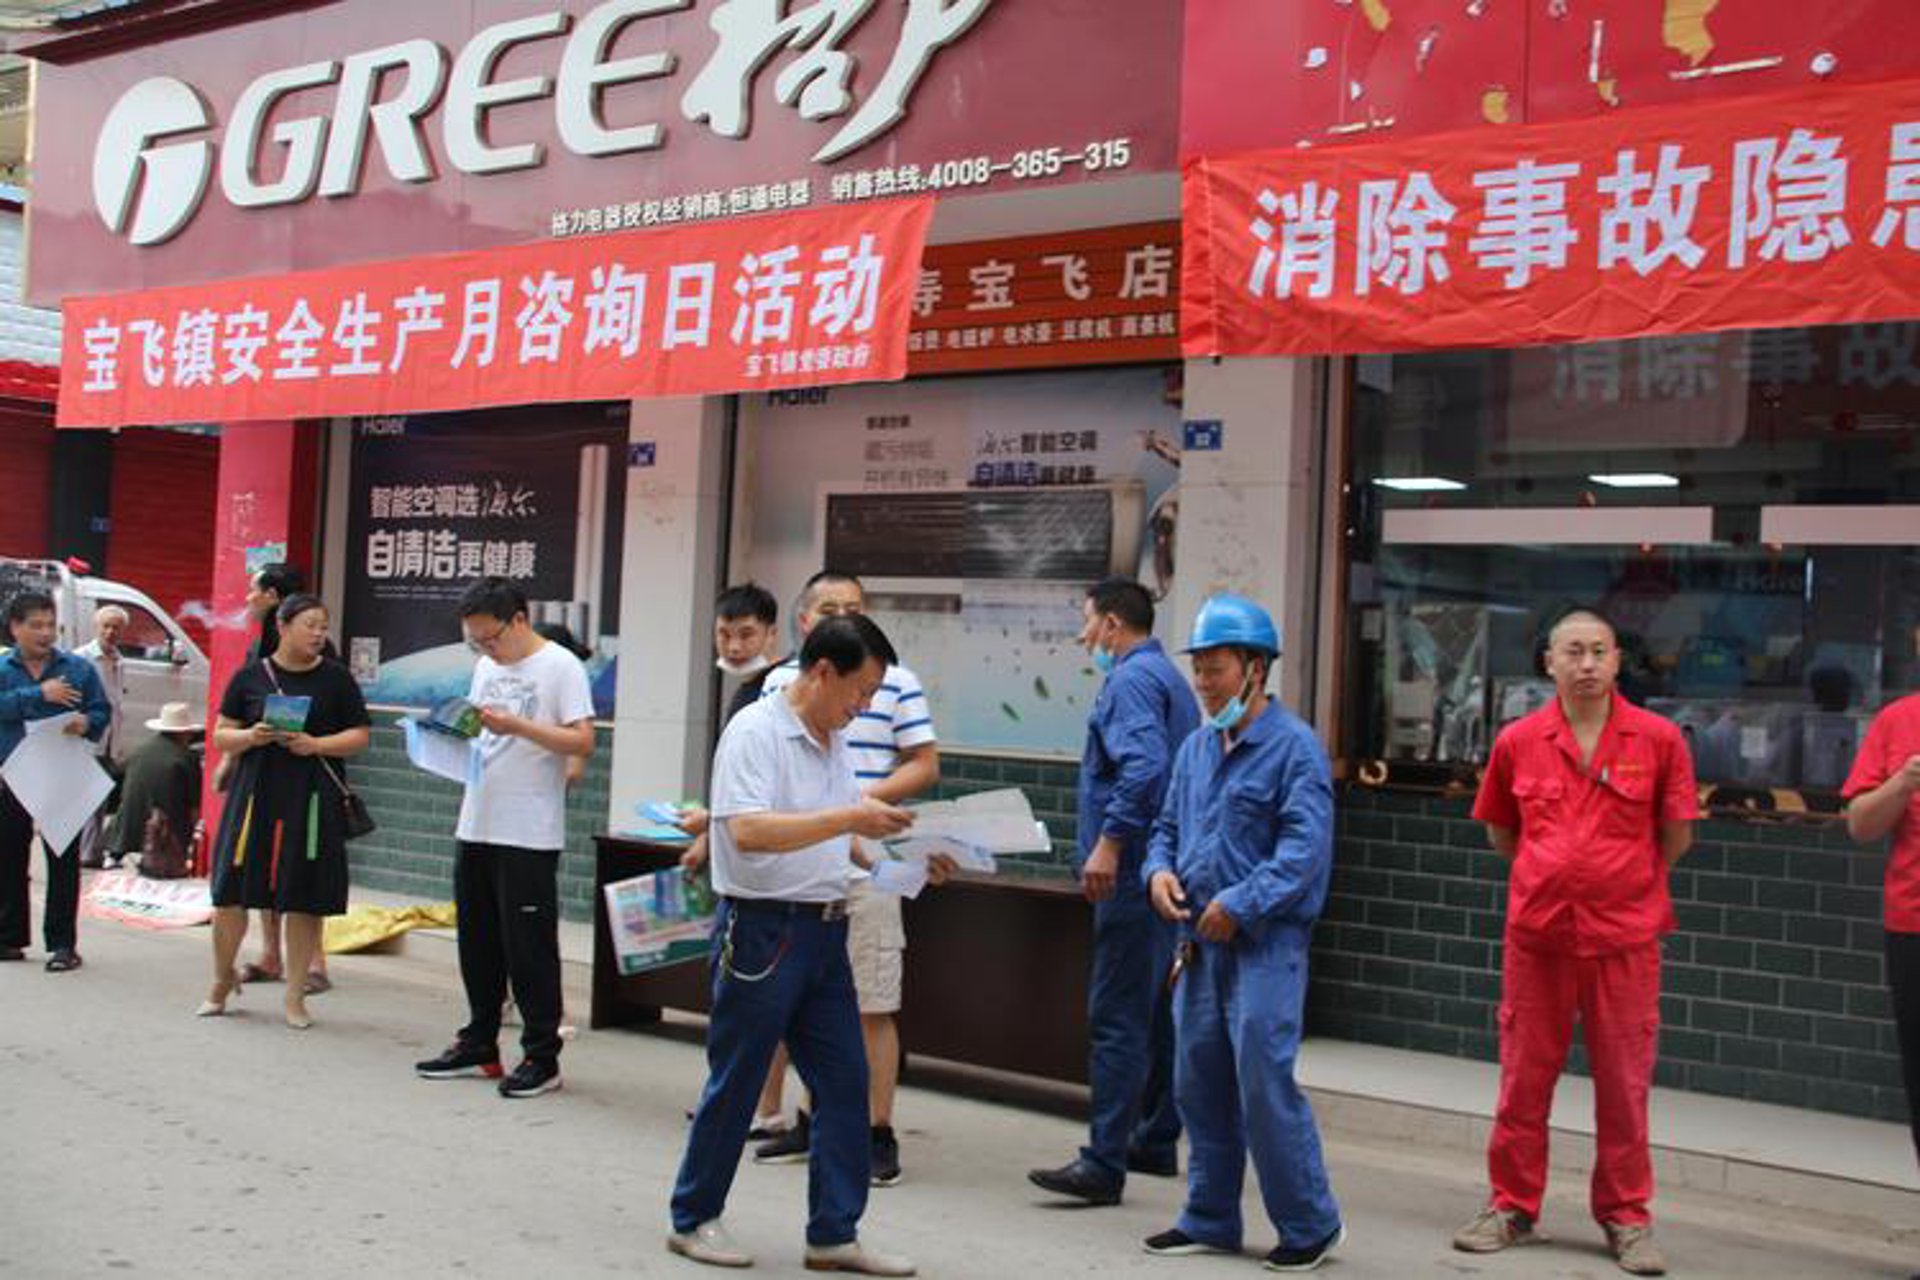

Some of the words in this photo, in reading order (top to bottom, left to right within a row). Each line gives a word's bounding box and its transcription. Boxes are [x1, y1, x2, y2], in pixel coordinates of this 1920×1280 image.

[220, 0, 692, 208] GREE
[82, 233, 886, 394] 宝飞镇安全生产月咨询日活动
[367, 529, 537, 580] 自清洁更健康
